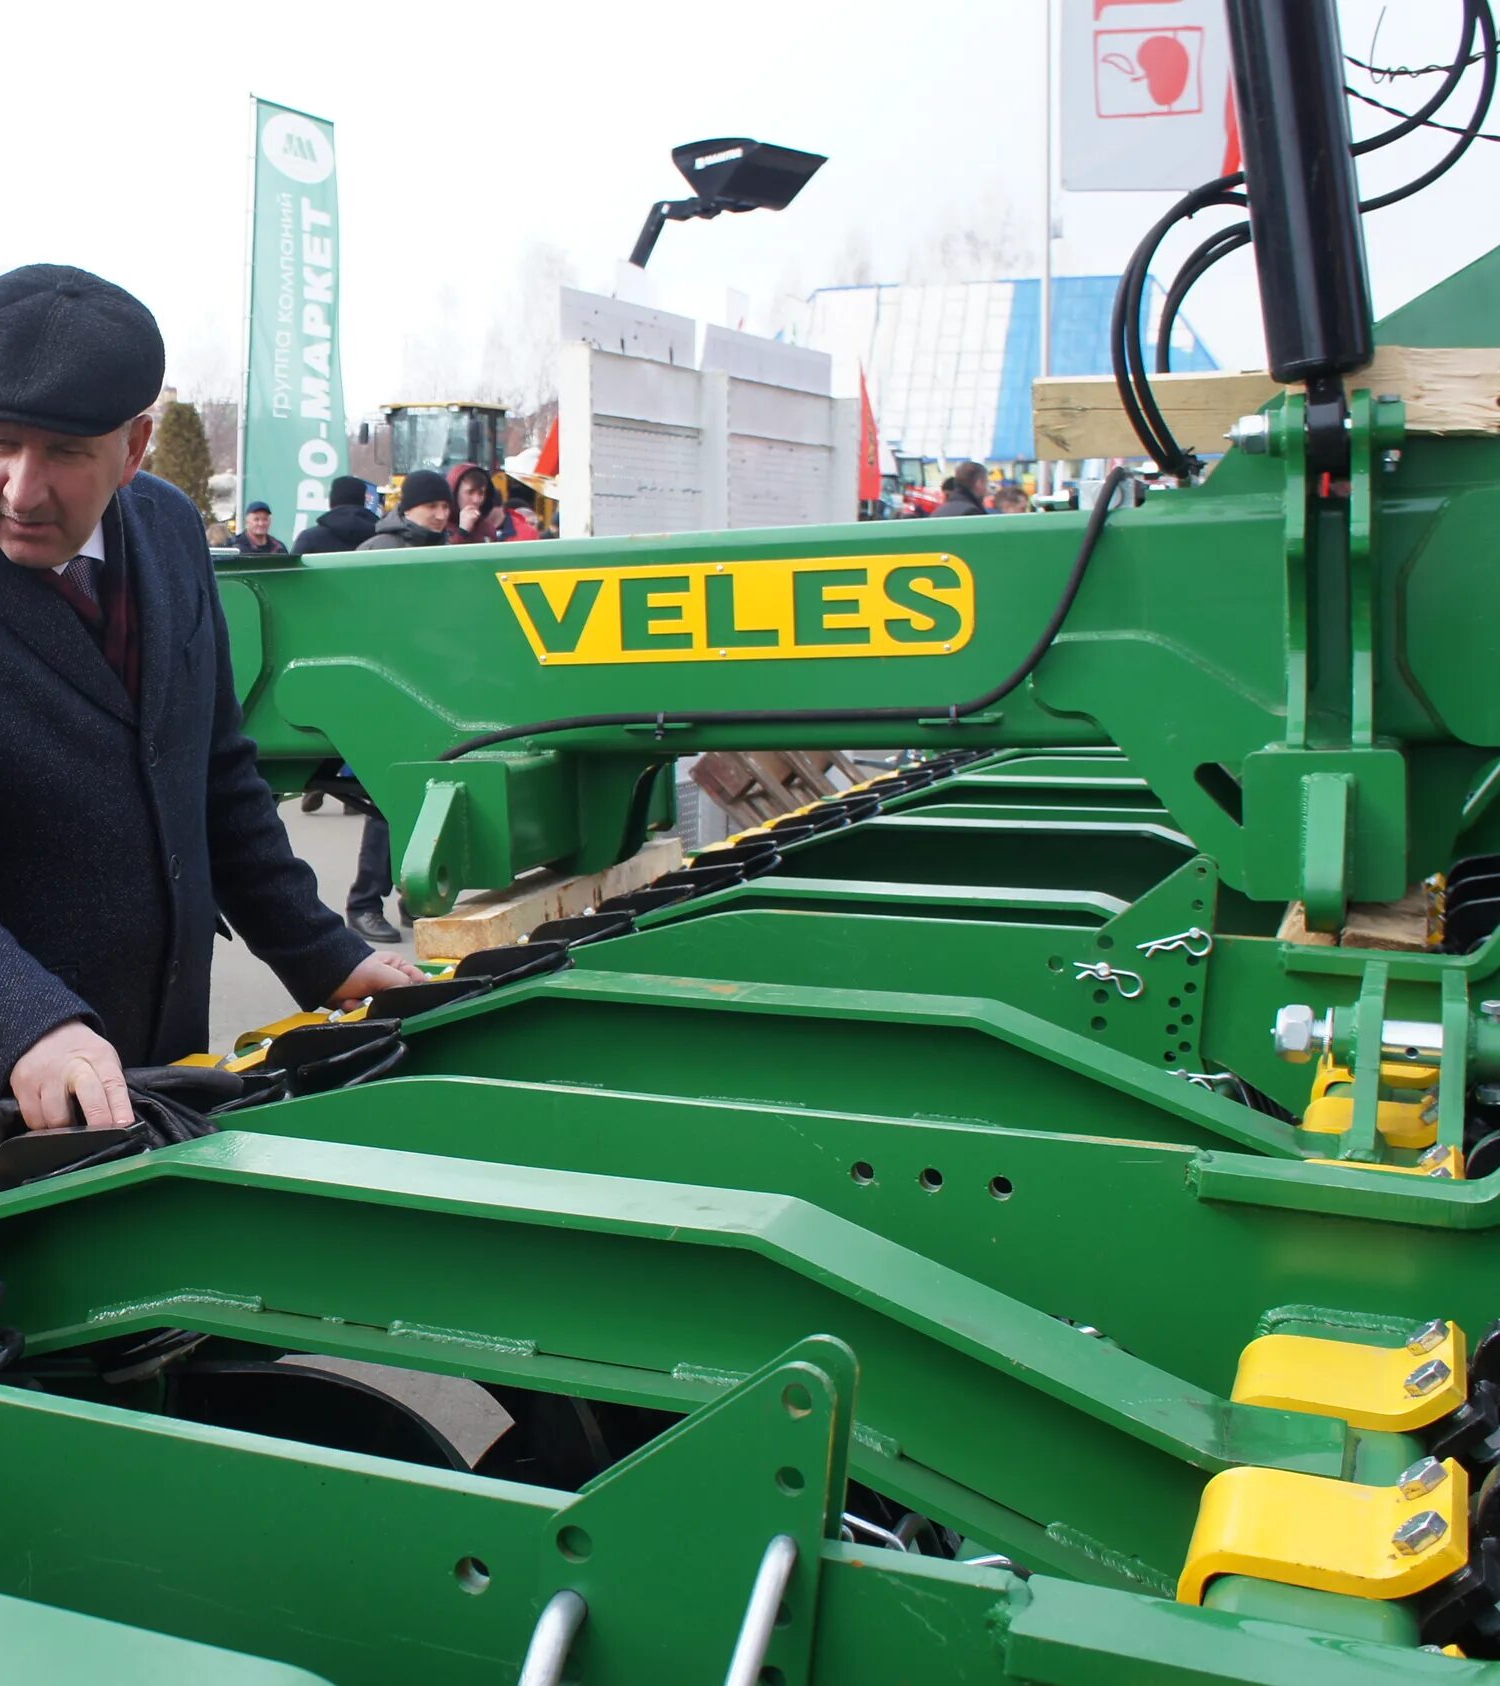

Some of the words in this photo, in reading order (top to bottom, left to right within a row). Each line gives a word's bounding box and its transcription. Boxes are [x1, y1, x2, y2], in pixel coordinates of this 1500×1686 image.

[277, 193, 295, 324] компаний
[273, 332, 292, 419] группа
[512, 564, 962, 653] VELES
